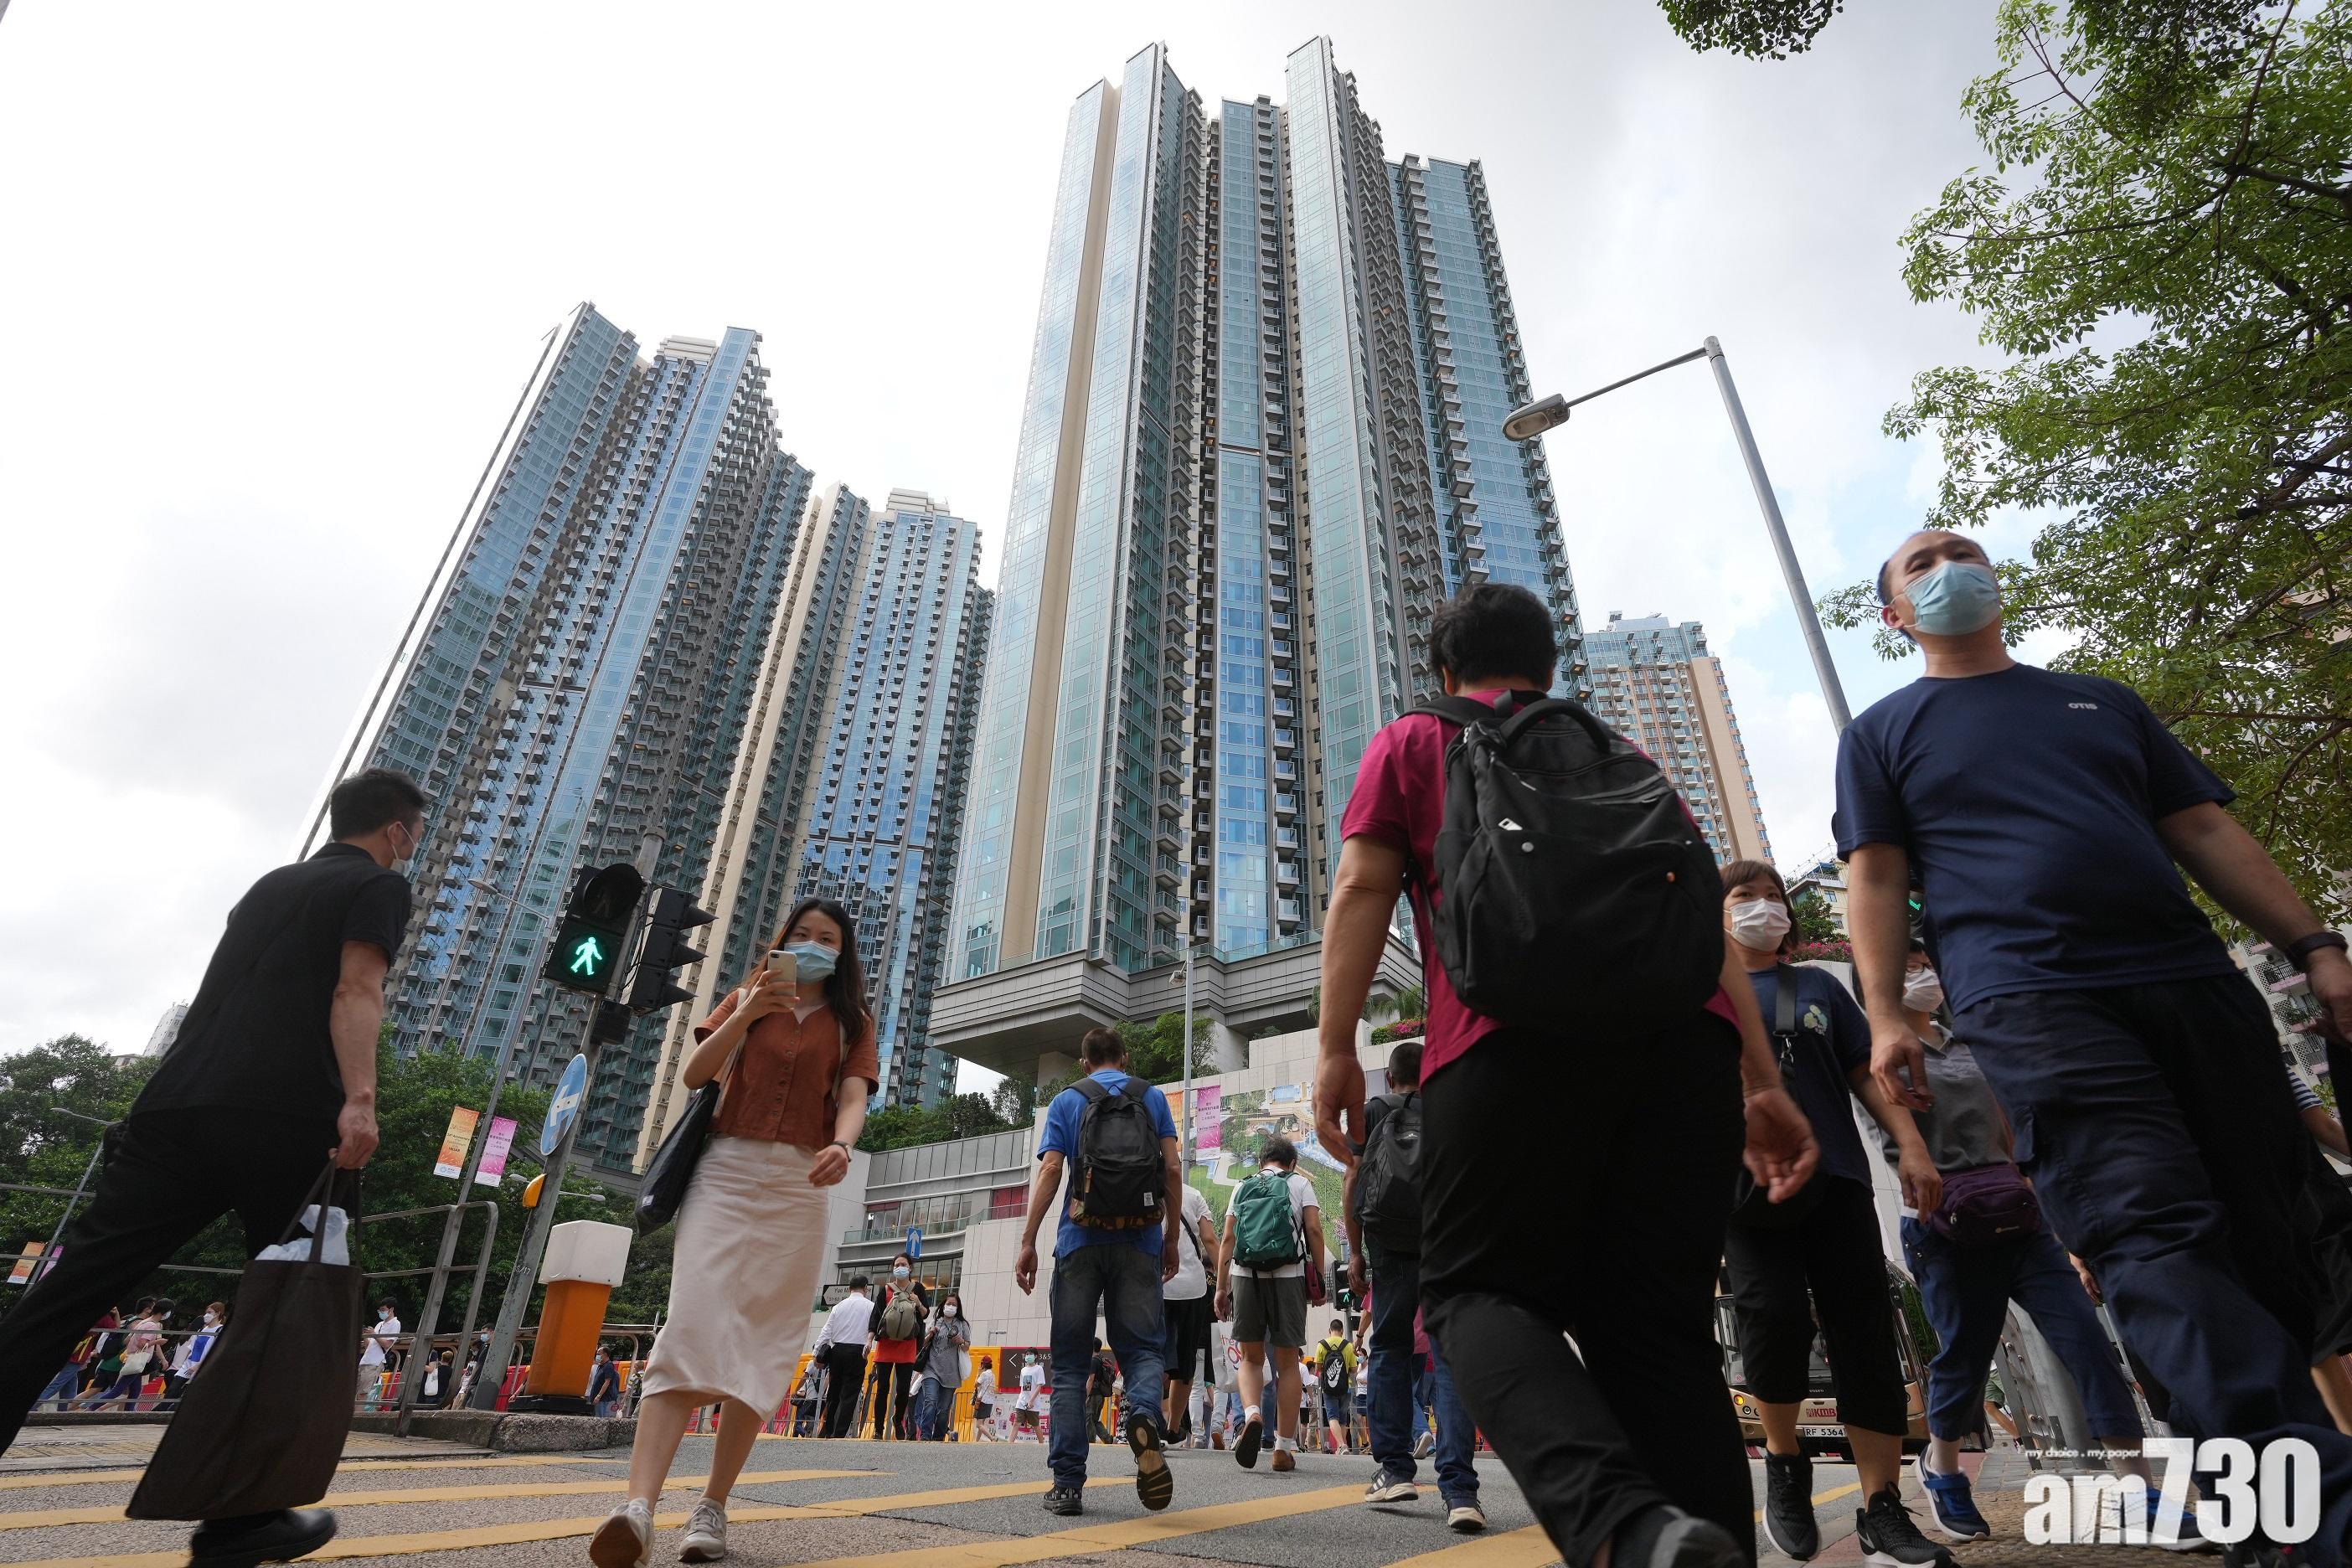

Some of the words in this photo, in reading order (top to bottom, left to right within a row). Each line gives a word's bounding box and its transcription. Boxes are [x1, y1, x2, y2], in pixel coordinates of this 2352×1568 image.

[1813, 1408, 1836, 1417] KMB
[1806, 1428, 1817, 1436] RF
[1821, 1428, 1844, 1436] 5364
